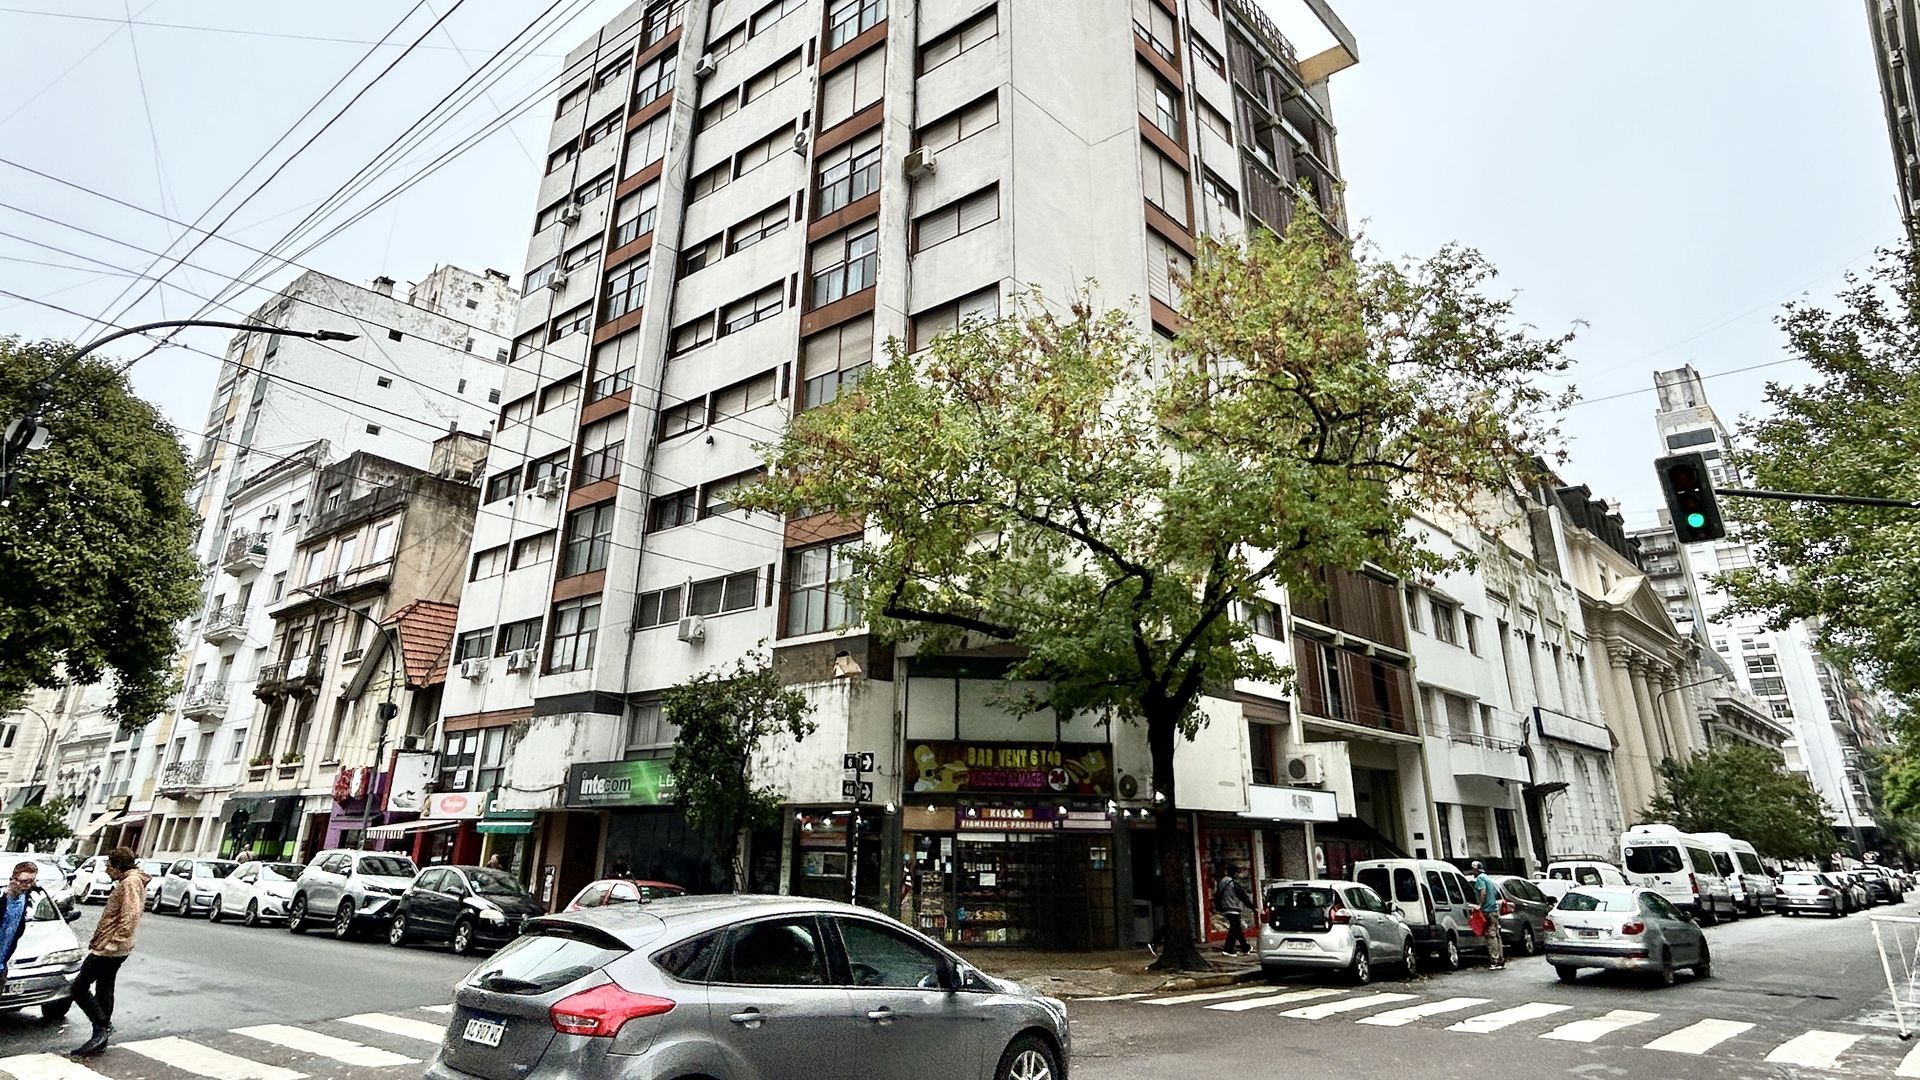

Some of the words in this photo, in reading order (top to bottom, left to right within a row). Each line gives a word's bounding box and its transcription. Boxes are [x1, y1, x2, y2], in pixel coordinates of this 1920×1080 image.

[847, 758, 853, 768] 6
[967, 747, 993, 767] BAR
[1030, 749, 1038, 766] 6
[1050, 770, 1066, 784] 24
[989, 809, 1025, 819] KIOSO
